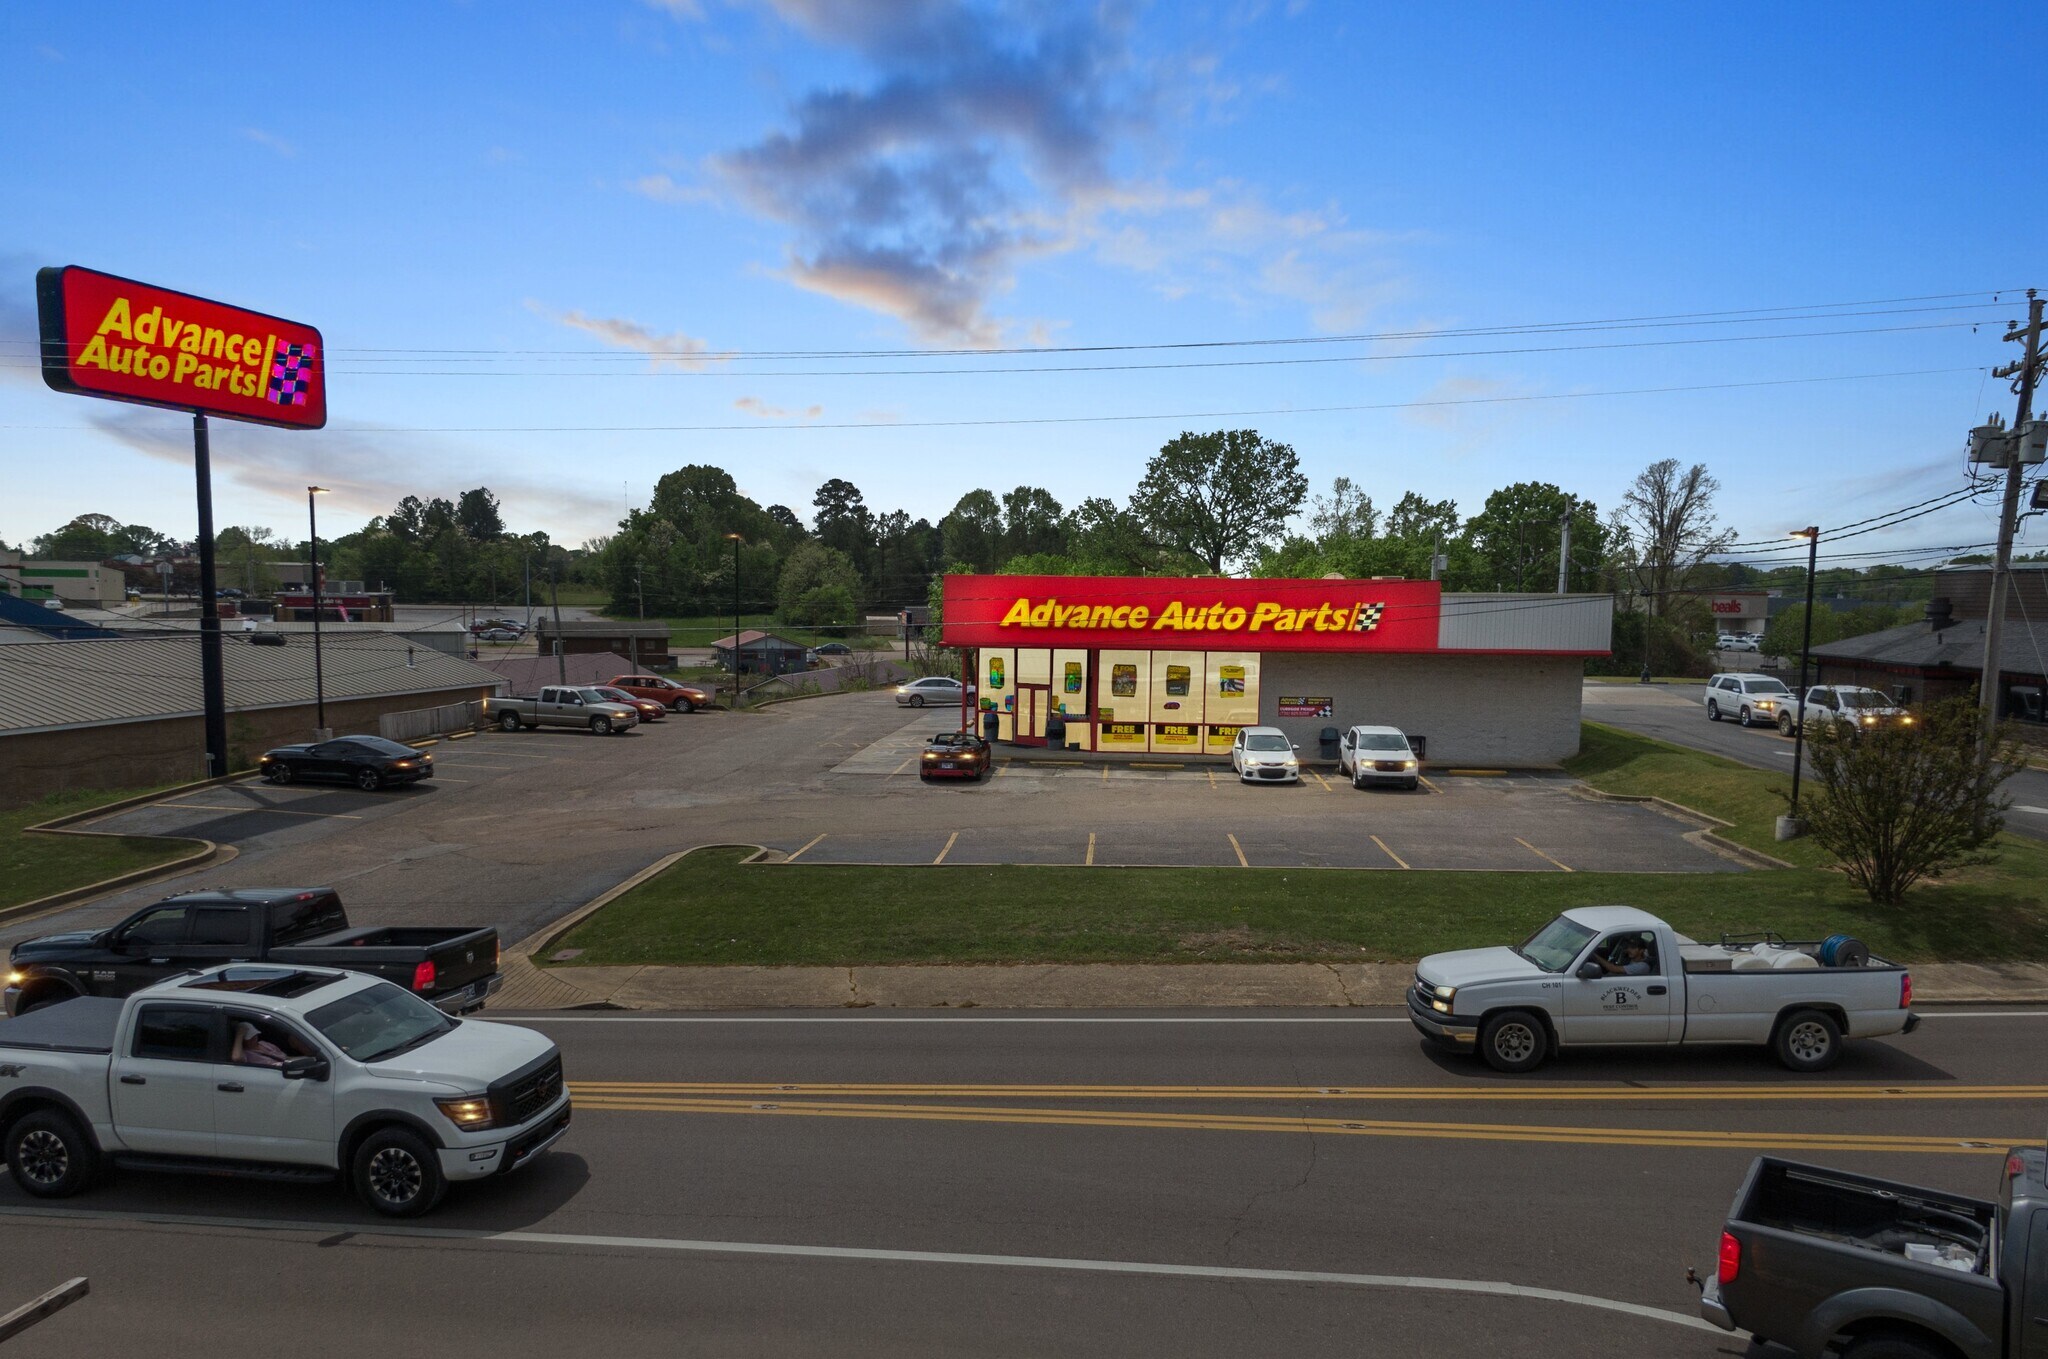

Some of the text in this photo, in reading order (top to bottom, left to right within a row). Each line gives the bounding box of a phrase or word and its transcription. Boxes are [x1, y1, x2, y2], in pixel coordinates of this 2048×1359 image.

[97, 297, 262, 366] Advance
[76, 334, 257, 397] Auto Parts
[1712, 598, 1741, 613] bealls
[1000, 598, 1350, 632] Advance Auto Parts
[1112, 725, 1135, 733] FREE
[1165, 726, 1188, 734] FREE
[1600, 986, 1641, 1001] BLACKWELDER
[1615, 992, 1626, 1004] B
